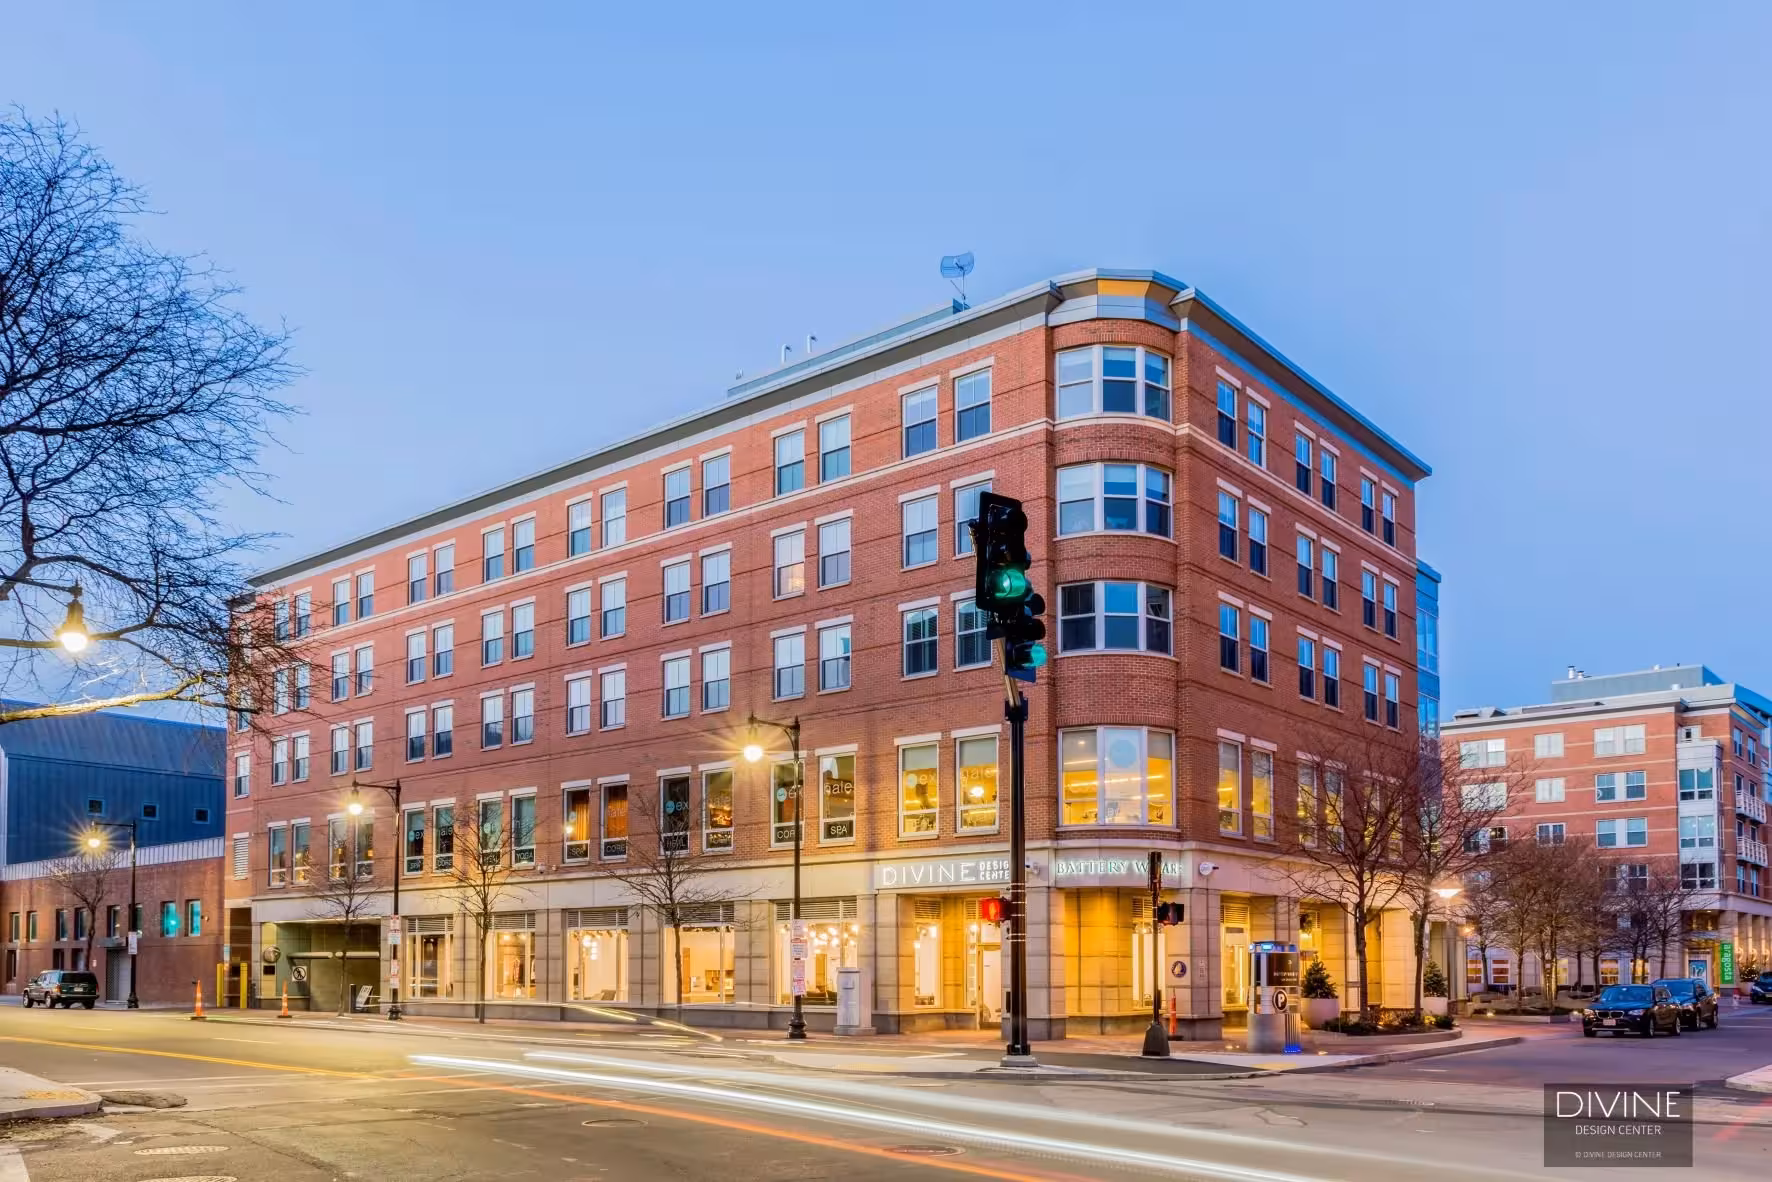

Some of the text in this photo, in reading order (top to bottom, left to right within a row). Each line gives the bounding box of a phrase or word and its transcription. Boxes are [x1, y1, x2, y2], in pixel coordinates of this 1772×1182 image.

[830, 825, 848, 836] SPA
[516, 852, 534, 861] YOGA
[979, 860, 1010, 871] DESIG
[1056, 860, 1127, 874] BATTERY
[883, 862, 976, 886] DIVINE
[979, 870, 1010, 881] CENTE
